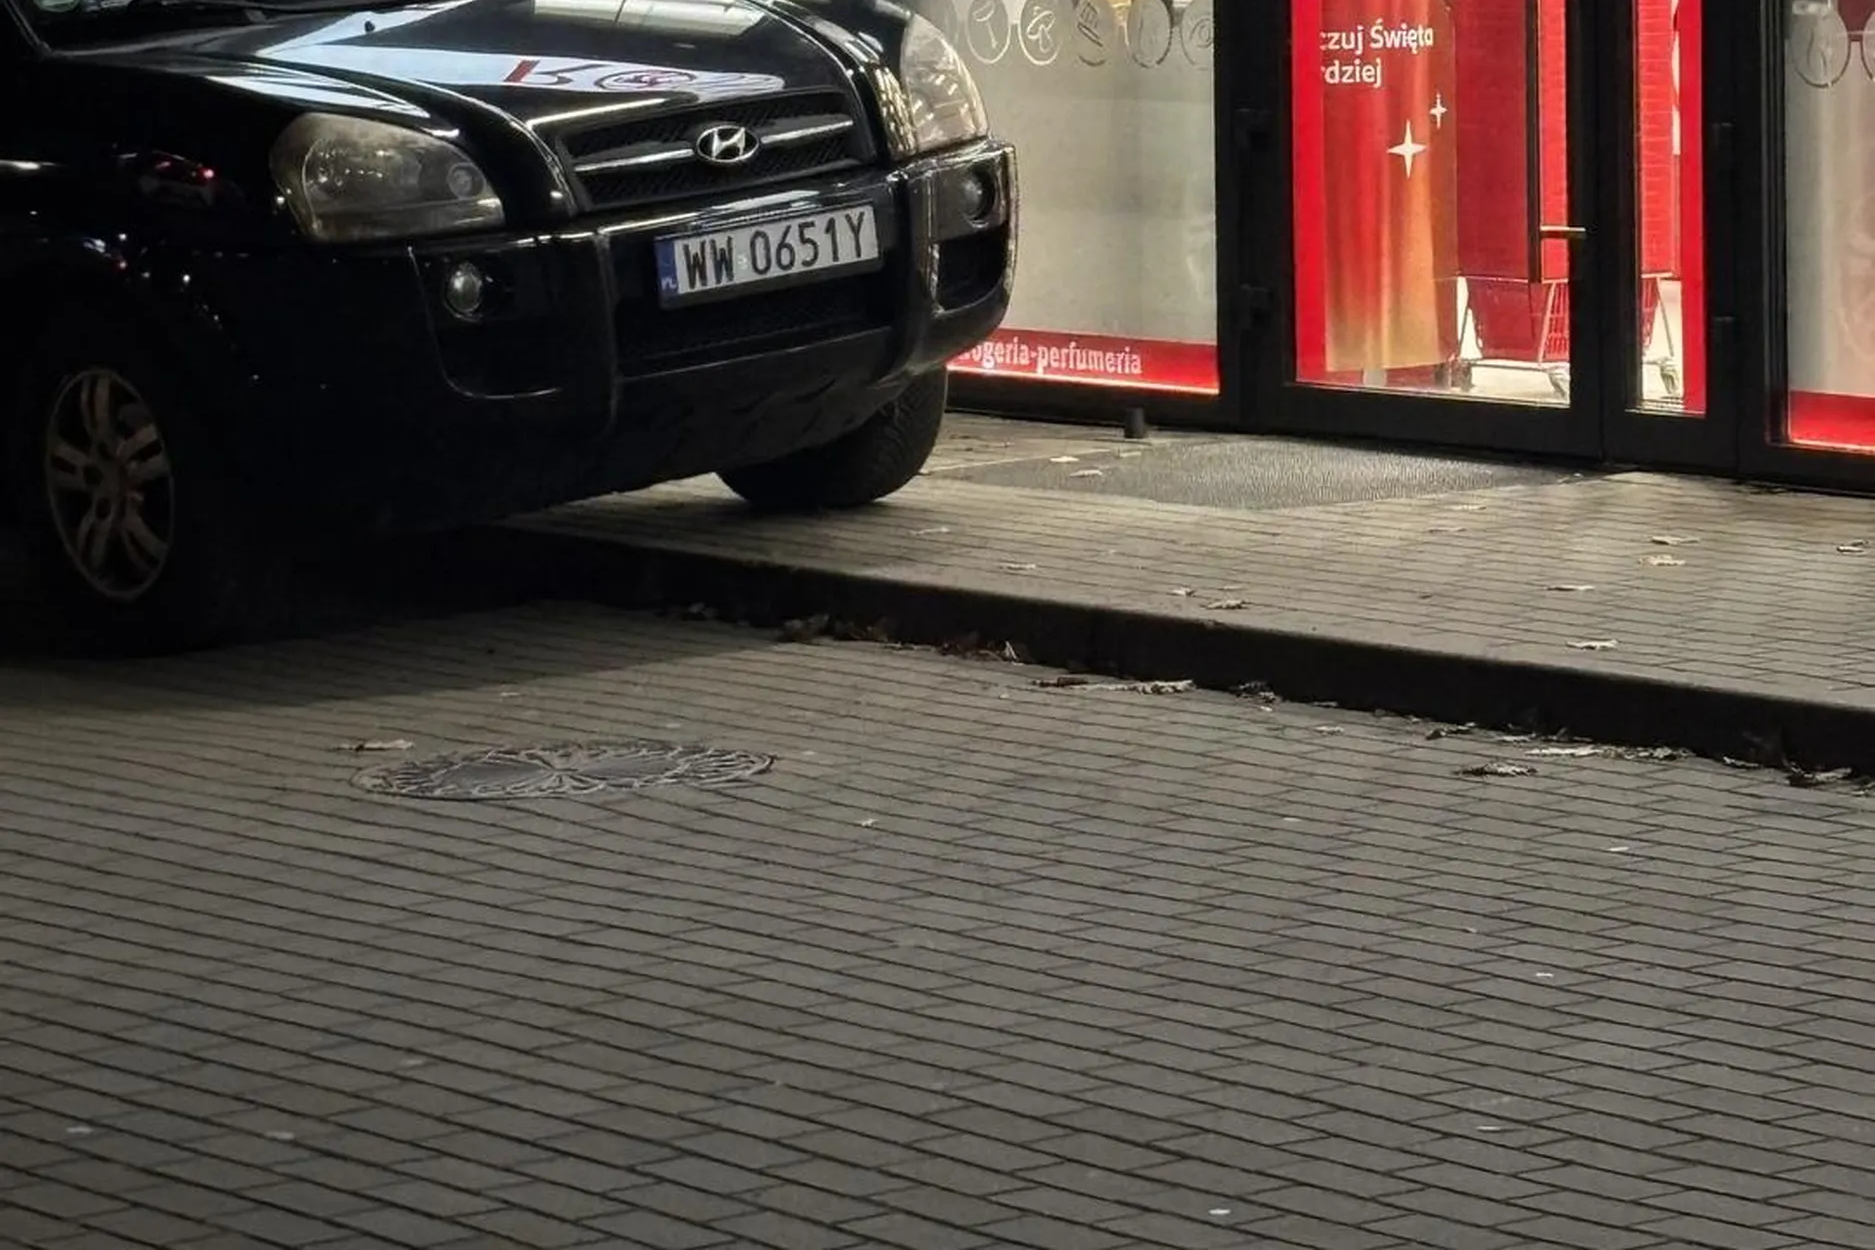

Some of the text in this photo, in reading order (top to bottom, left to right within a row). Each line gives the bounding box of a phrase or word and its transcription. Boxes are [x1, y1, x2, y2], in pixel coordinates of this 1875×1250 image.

[1369, 17, 1434, 55] Święta
[1320, 57, 1382, 89] dziej
[683, 211, 866, 290] WW 0651Y
